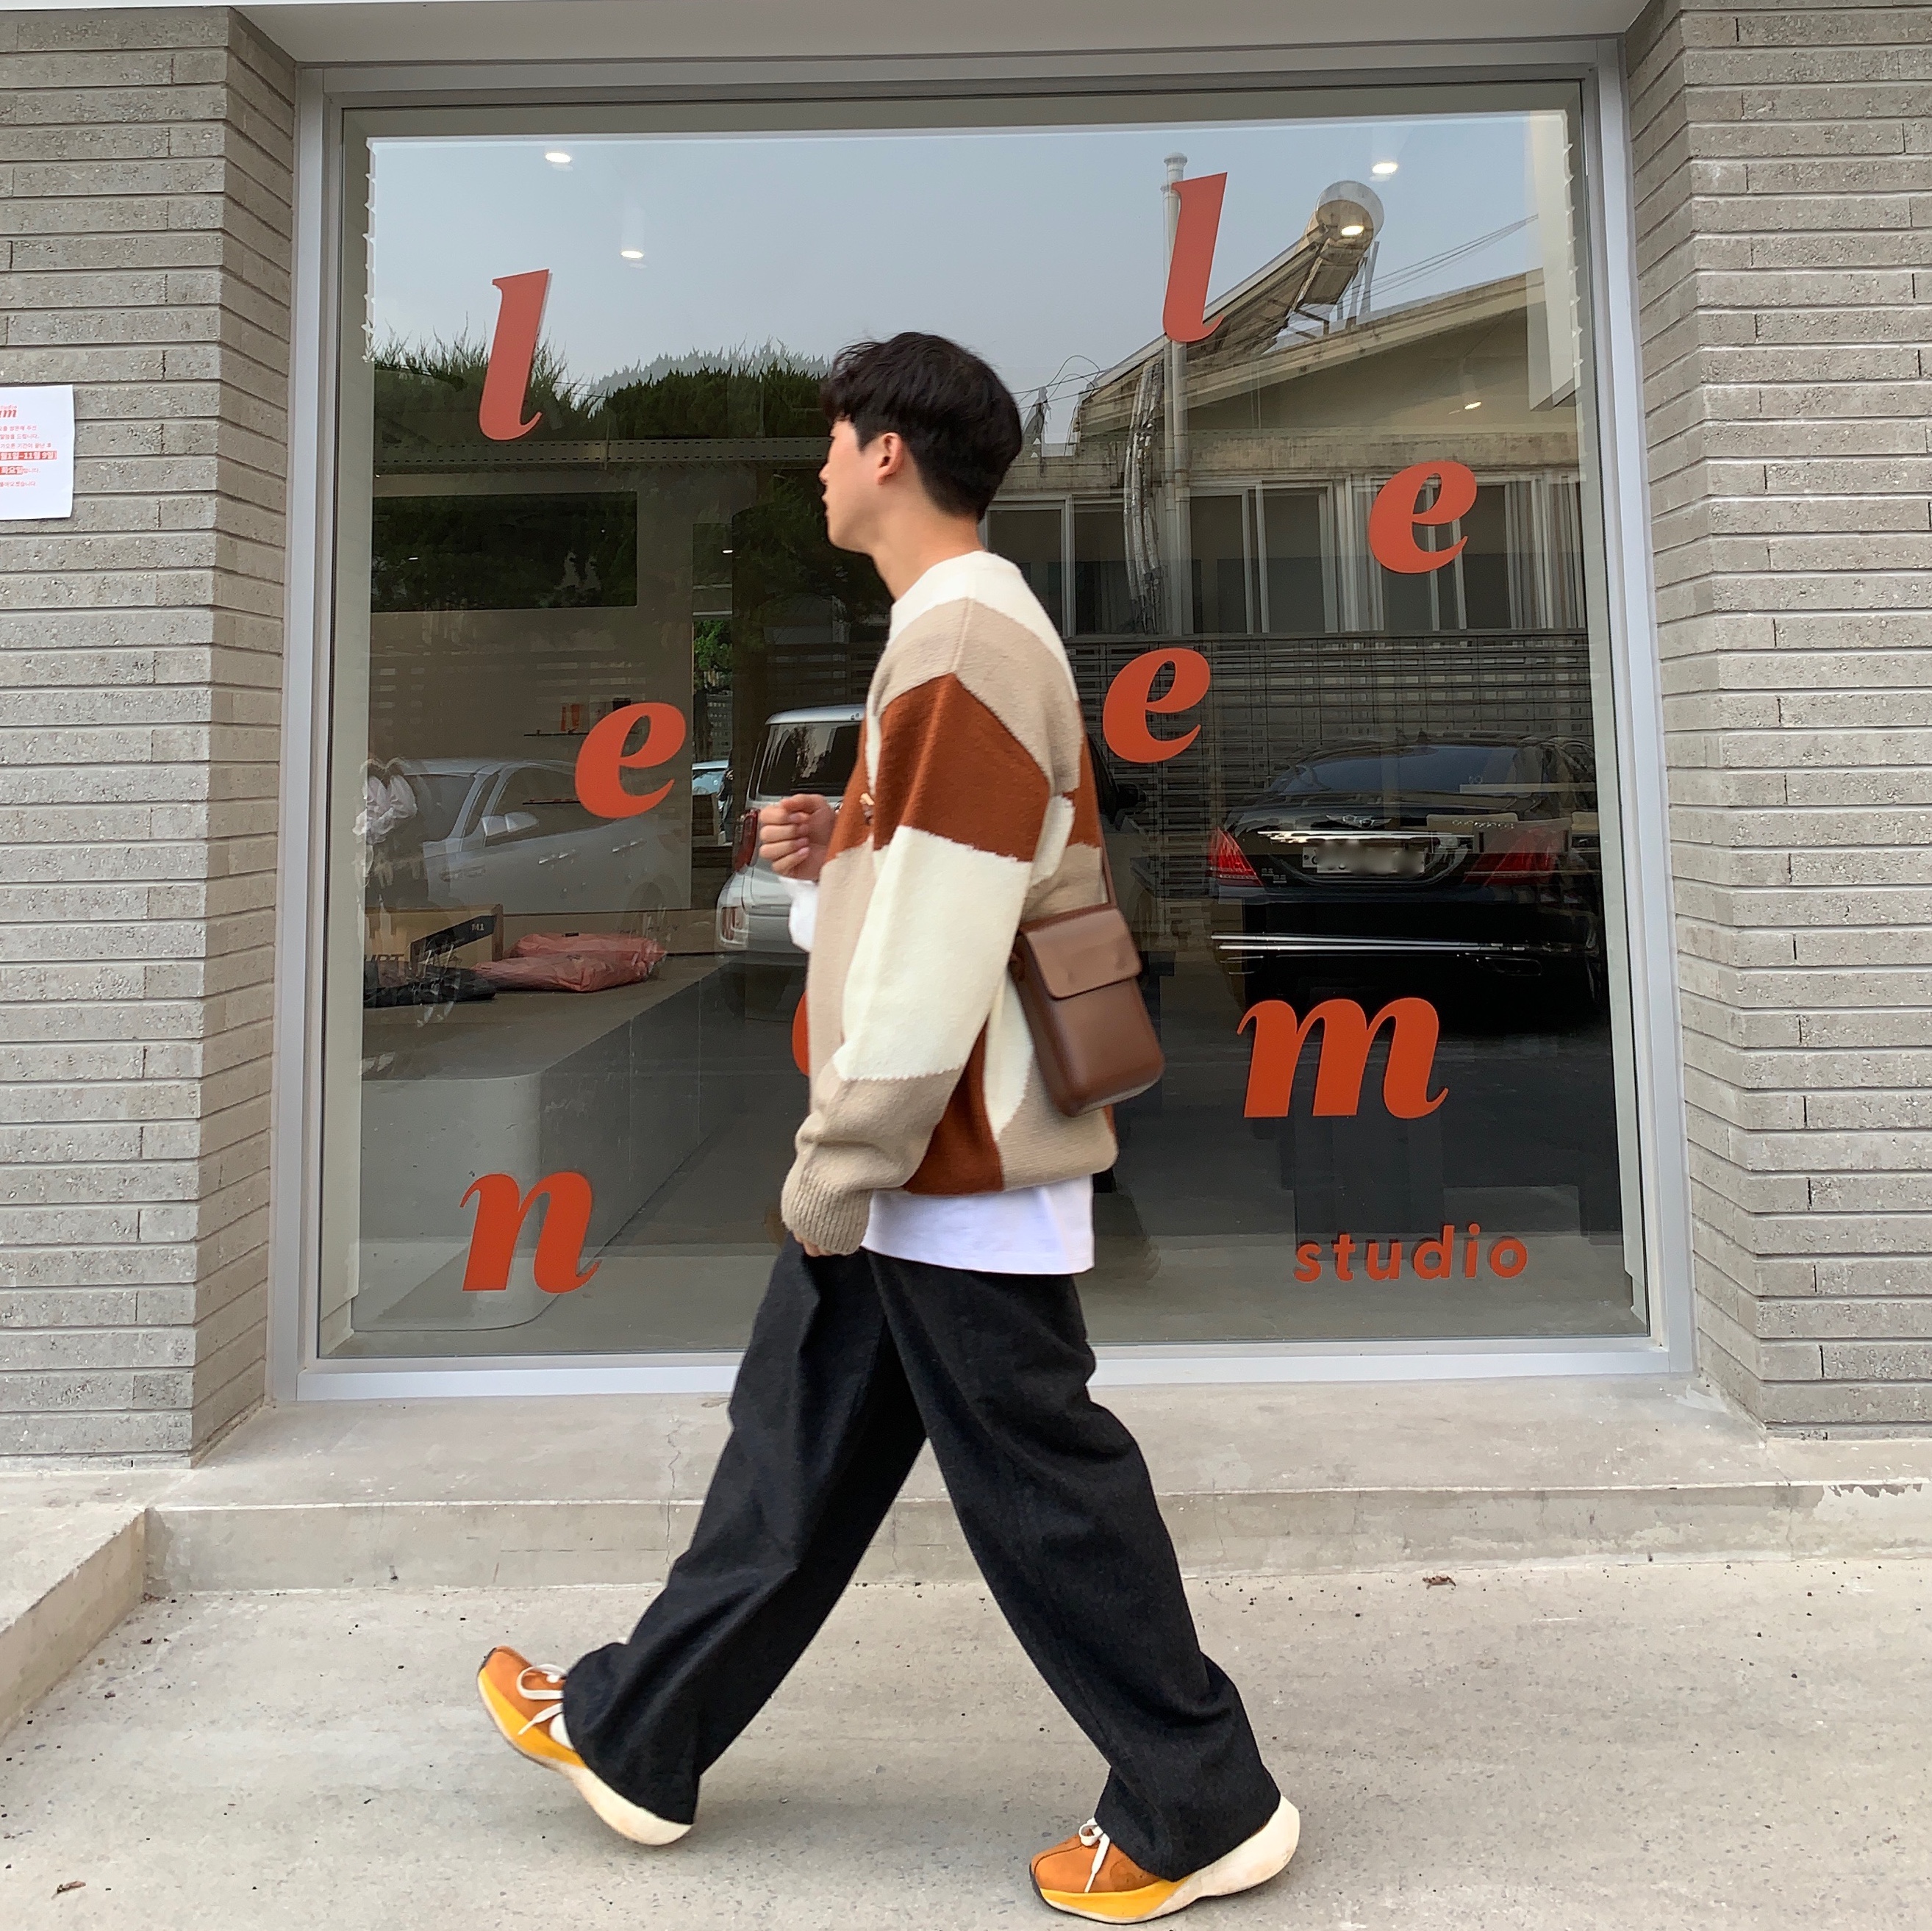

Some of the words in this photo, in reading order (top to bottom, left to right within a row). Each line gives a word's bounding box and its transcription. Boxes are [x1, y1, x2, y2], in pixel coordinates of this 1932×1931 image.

[1164, 173, 1227, 342] l
[479, 270, 549, 440] l
[1368, 460, 1477, 573] e
[575, 702, 686, 818] e
[1102, 648, 1213, 763] e
[1237, 997, 1449, 1119] m
[461, 1172, 598, 1293] n
[1293, 1222, 1528, 1282] studio
